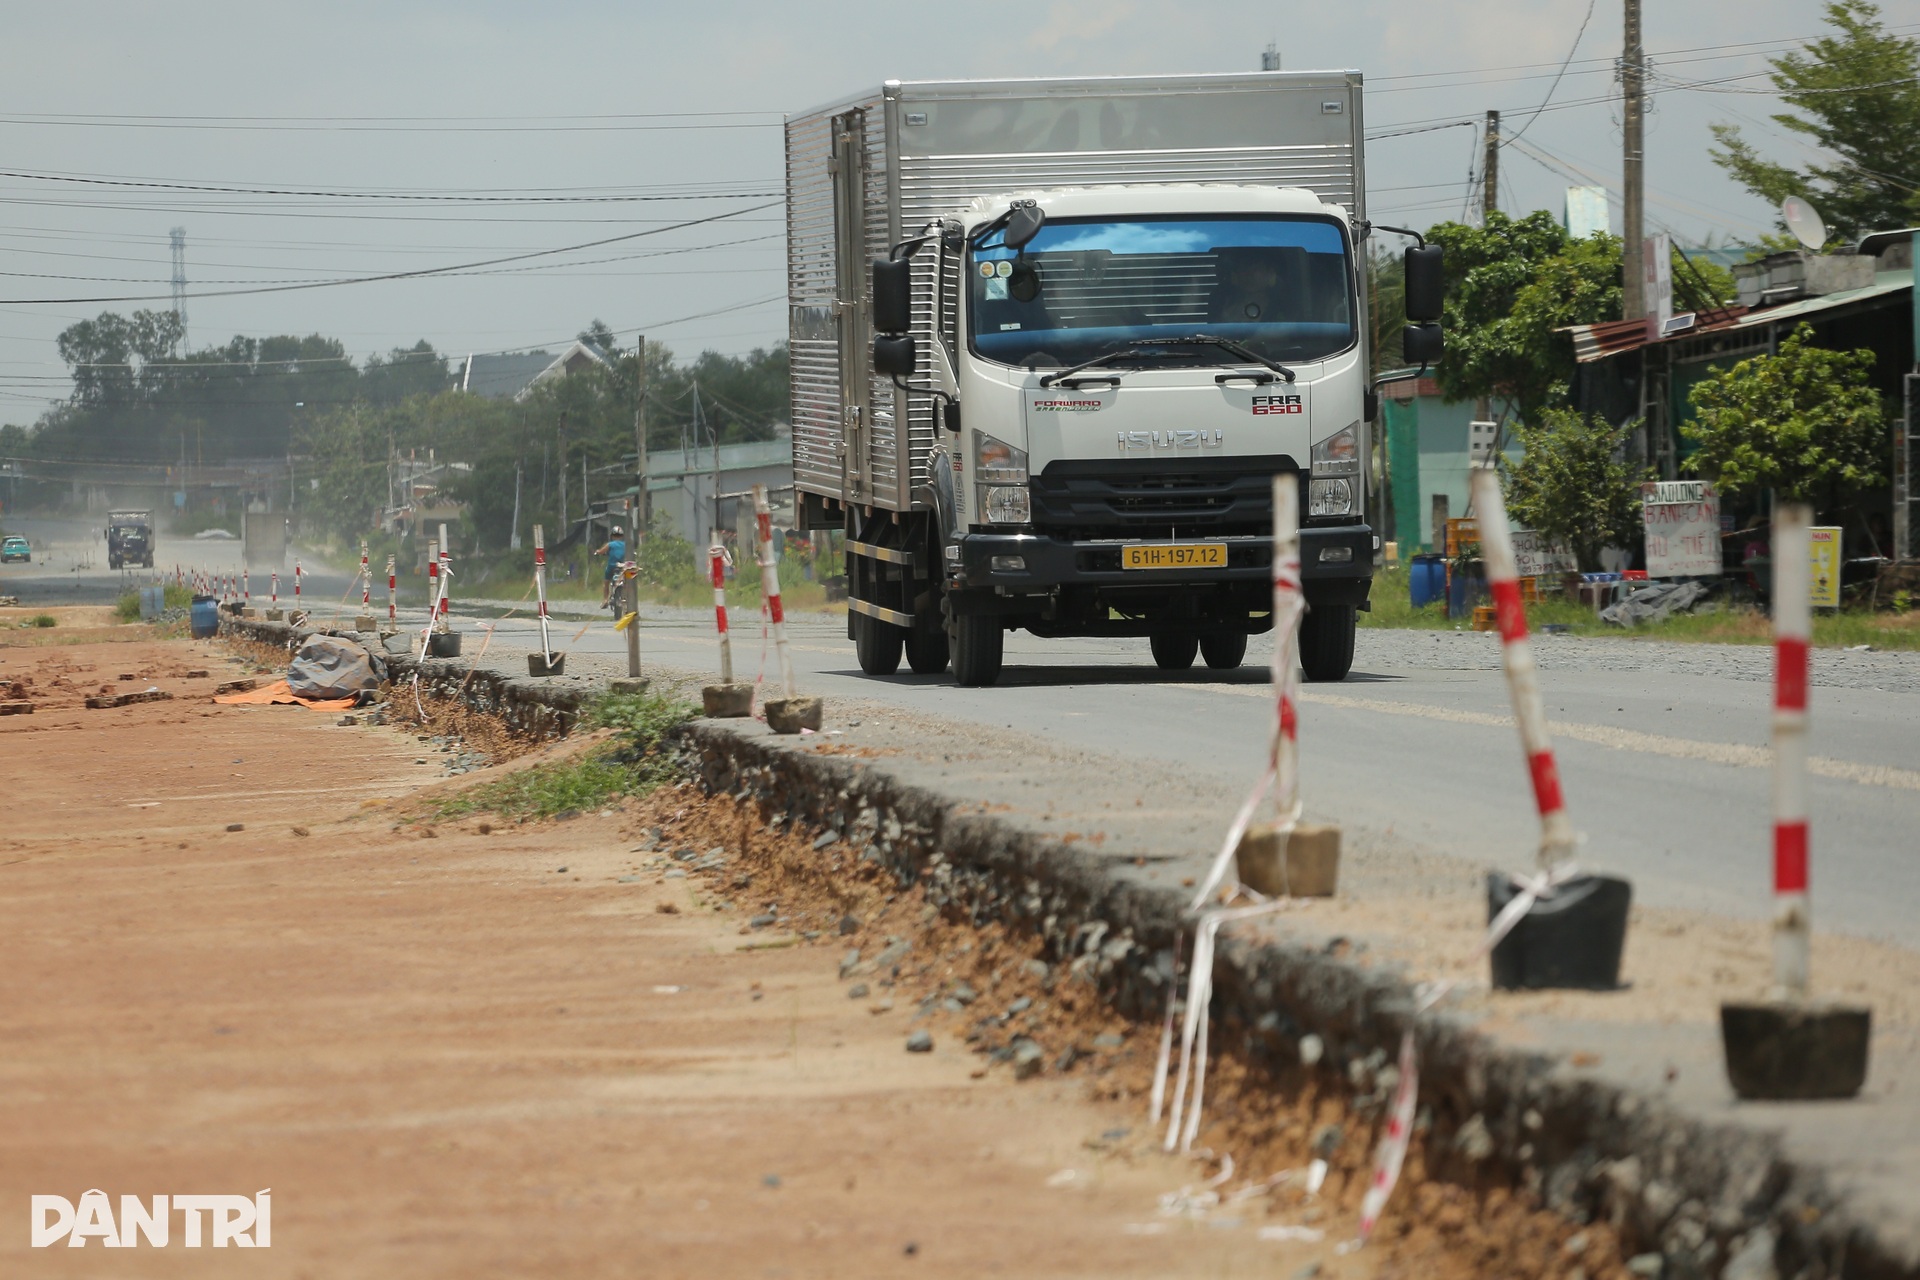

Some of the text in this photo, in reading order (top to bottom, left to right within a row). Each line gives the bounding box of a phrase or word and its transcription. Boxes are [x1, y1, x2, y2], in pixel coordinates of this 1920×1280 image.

[1251, 395, 1302, 405] FRR
[1252, 405, 1303, 415] 650
[1117, 428, 1224, 451] ISUZU
[1131, 548, 1218, 564] 61H-197.12
